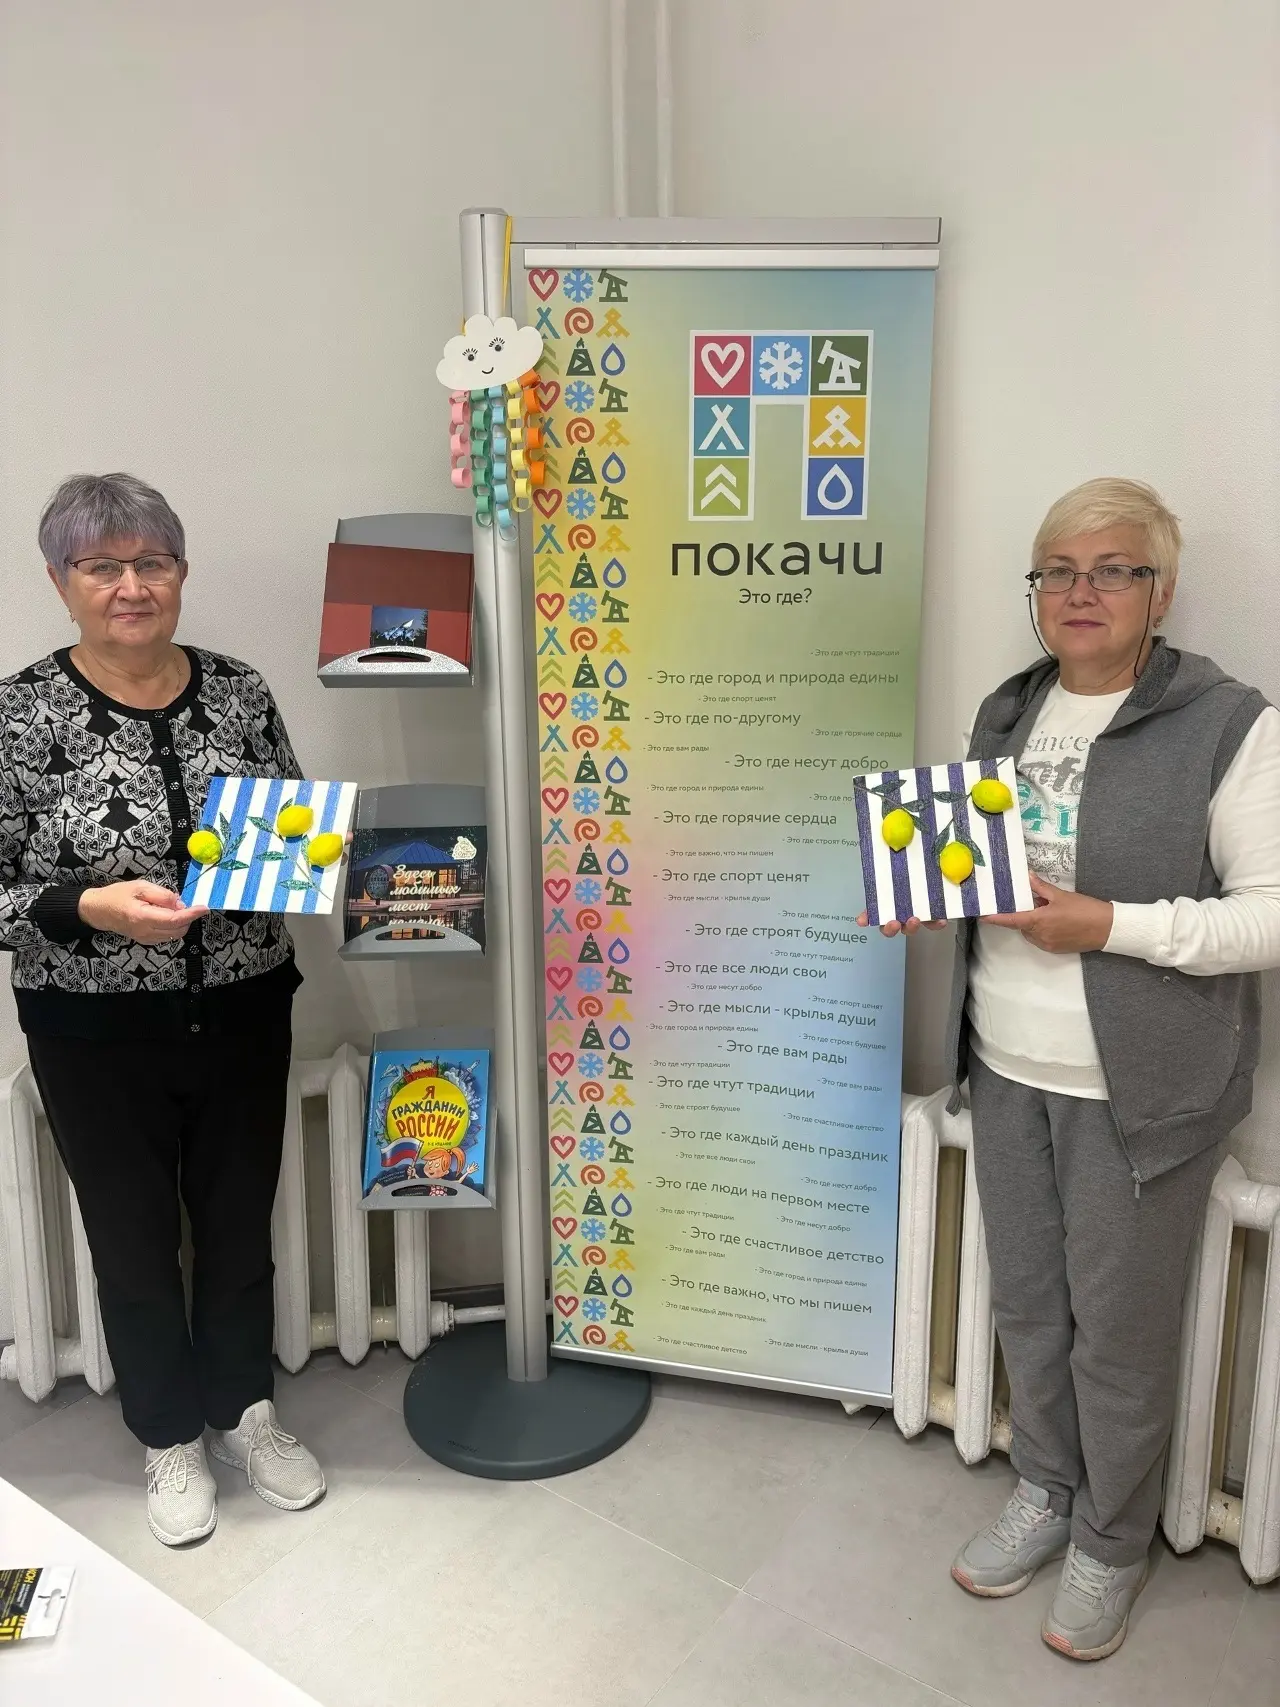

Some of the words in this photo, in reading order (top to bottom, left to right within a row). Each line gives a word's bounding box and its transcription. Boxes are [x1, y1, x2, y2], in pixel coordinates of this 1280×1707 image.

[671, 541, 883, 577] покачи
[738, 588, 771, 604] Это
[776, 587, 812, 605] где?
[656, 669, 685, 683] Это
[689, 674, 713, 685] где
[717, 673, 761, 686] город
[765, 673, 774, 683] и
[779, 673, 844, 686] природа
[849, 672, 898, 684] едины
[702, 694, 717, 703] Это
[731, 696, 754, 704] спорт
[653, 710, 681, 724] Это
[685, 714, 709, 725] где
[713, 714, 801, 726] по-другому
[814, 728, 830, 737] Это
[830, 730, 844, 738] где
[844, 729, 875, 738] горячие
[875, 731, 903, 740] сердца
[733, 753, 762, 767] Это
[766, 758, 789, 769] где
[794, 758, 837, 770] несут
[839, 755, 889, 769] добро
[650, 783, 665, 792] Это
[678, 785, 701, 793] город
[707, 785, 740, 793] природа
[813, 792, 828, 801] Это
[662, 810, 690, 823] Это
[694, 814, 718, 824] где
[722, 813, 780, 826] горячие
[784, 814, 836, 826] сердца
[786, 835, 801, 844] Это
[661, 868, 689, 881] Это
[693, 872, 716, 882] где
[719, 872, 763, 884] спорт
[766, 872, 810, 883] ценят
[781, 909, 797, 918] Это
[810, 913, 831, 921] люди
[694, 923, 721, 935] Это
[725, 927, 748, 937] где
[751, 927, 801, 939] строят
[804, 925, 868, 944] будущее
[774, 949, 789, 957] Это
[789, 951, 802, 959] где
[802, 953, 818, 961] чтут
[818, 954, 854, 963] традиции
[664, 960, 691, 972] Это
[695, 964, 718, 974] где
[721, 964, 746, 973] все
[749, 965, 788, 976] люди
[792, 967, 826, 978] свои
[690, 982, 705, 990] Это
[718, 984, 740, 992] несут
[739, 983, 763, 992] добро
[811, 994, 826, 1004] Это
[826, 998, 839, 1006] где
[838, 1000, 861, 1009] спорт
[861, 1003, 883, 1013] ценят
[667, 999, 694, 1012] Это
[698, 1004, 720, 1014] где
[724, 1004, 770, 1014] мысли
[783, 1007, 833, 1021] крылья
[837, 1013, 875, 1026] души
[649, 1022, 664, 1031] Это
[802, 1032, 817, 1041] Это
[816, 1036, 830, 1044] где
[829, 1038, 854, 1047] строят
[854, 1039, 887, 1050] будущее
[726, 1039, 753, 1052] Это
[757, 1044, 779, 1056] где
[783, 1047, 807, 1058] вам
[812, 1051, 847, 1064] рады
[653, 1059, 667, 1068] Это
[422, 1085, 436, 1100] Я
[656, 1075, 683, 1087] Это
[687, 1079, 709, 1089] где
[712, 1080, 743, 1092] чтут
[746, 1082, 814, 1098] традиции
[821, 1076, 836, 1086] Это
[836, 1081, 848, 1089] где
[848, 1083, 863, 1091] вам
[863, 1085, 883, 1093] рады
[392, 1100, 466, 1120] ГРАЖДАНИН
[659, 1102, 673, 1110] Это
[710, 1104, 741, 1113] будущее
[396, 1113, 460, 1141] РОССИИ
[787, 1112, 801, 1121] Это
[813, 1118, 855, 1130] счастливое
[854, 1124, 885, 1132] детство
[669, 1126, 696, 1138] Это
[700, 1131, 722, 1141] где
[725, 1132, 778, 1147] каждый
[781, 1139, 815, 1153] день
[818, 1146, 888, 1162] праздник
[804, 1176, 819, 1185] Это
[819, 1180, 831, 1188] где
[831, 1182, 853, 1191] несут
[853, 1183, 878, 1193] добро
[655, 1176, 681, 1188] Это
[685, 1181, 707, 1191] где
[710, 1183, 747, 1196] люди
[751, 1189, 766, 1199] на
[771, 1192, 822, 1208] первом
[827, 1201, 869, 1213] месте
[780, 1215, 794, 1224] Это
[794, 1219, 806, 1227] где
[806, 1222, 827, 1232] несут
[827, 1224, 851, 1233] добро
[690, 1226, 715, 1240] Это
[719, 1233, 740, 1244] где
[744, 1237, 823, 1257] счастливое
[826, 1251, 884, 1264] детство
[758, 1266, 773, 1275] Это
[772, 1270, 785, 1278] где
[784, 1273, 806, 1282] город
[812, 1277, 844, 1286] природа
[669, 1274, 694, 1289] Это
[698, 1282, 720, 1293] где
[723, 1285, 769, 1301] важно,
[772, 1293, 795, 1305] что
[799, 1298, 819, 1308] мы
[823, 1301, 871, 1313] пишем
